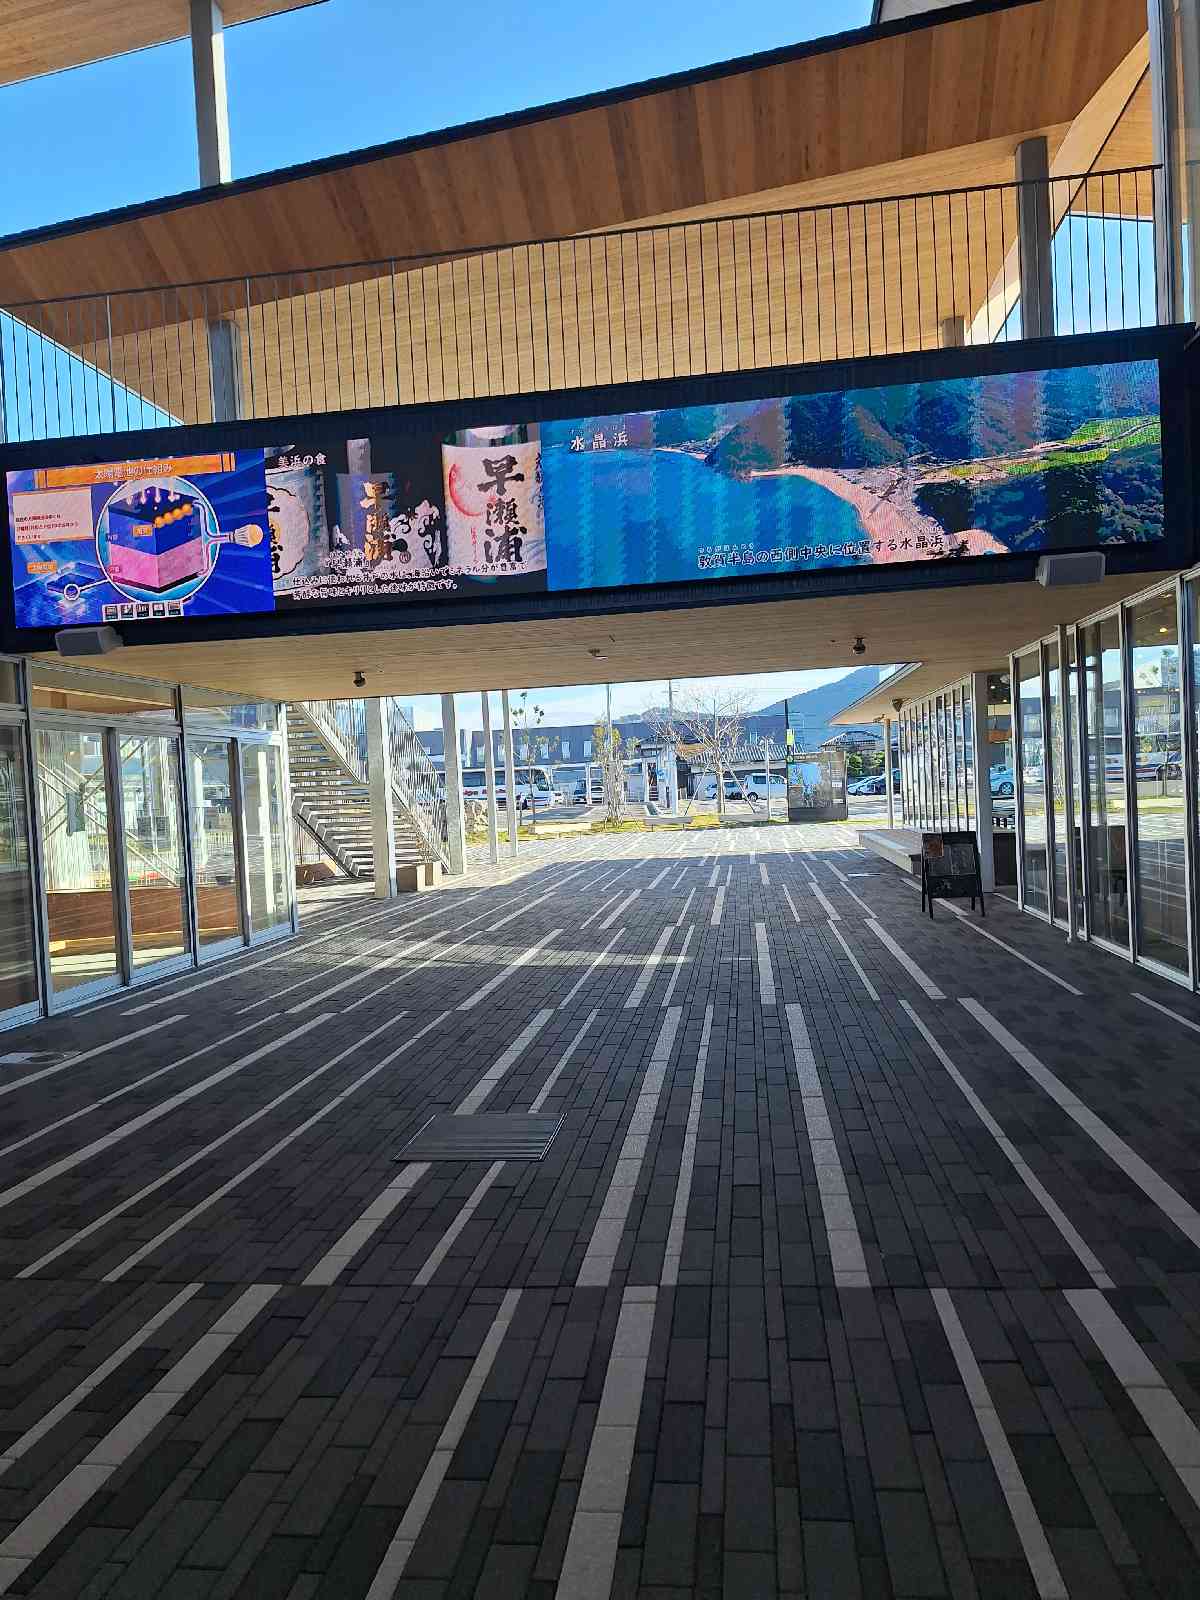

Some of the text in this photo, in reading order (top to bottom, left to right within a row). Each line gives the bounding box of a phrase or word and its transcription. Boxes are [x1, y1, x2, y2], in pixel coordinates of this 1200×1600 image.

[570, 431, 629, 452] 水晶浜
[278, 451, 327, 468] 美浜の食
[697, 534, 945, 570] 敦賀半島の西側中央に位置する水晶浜
